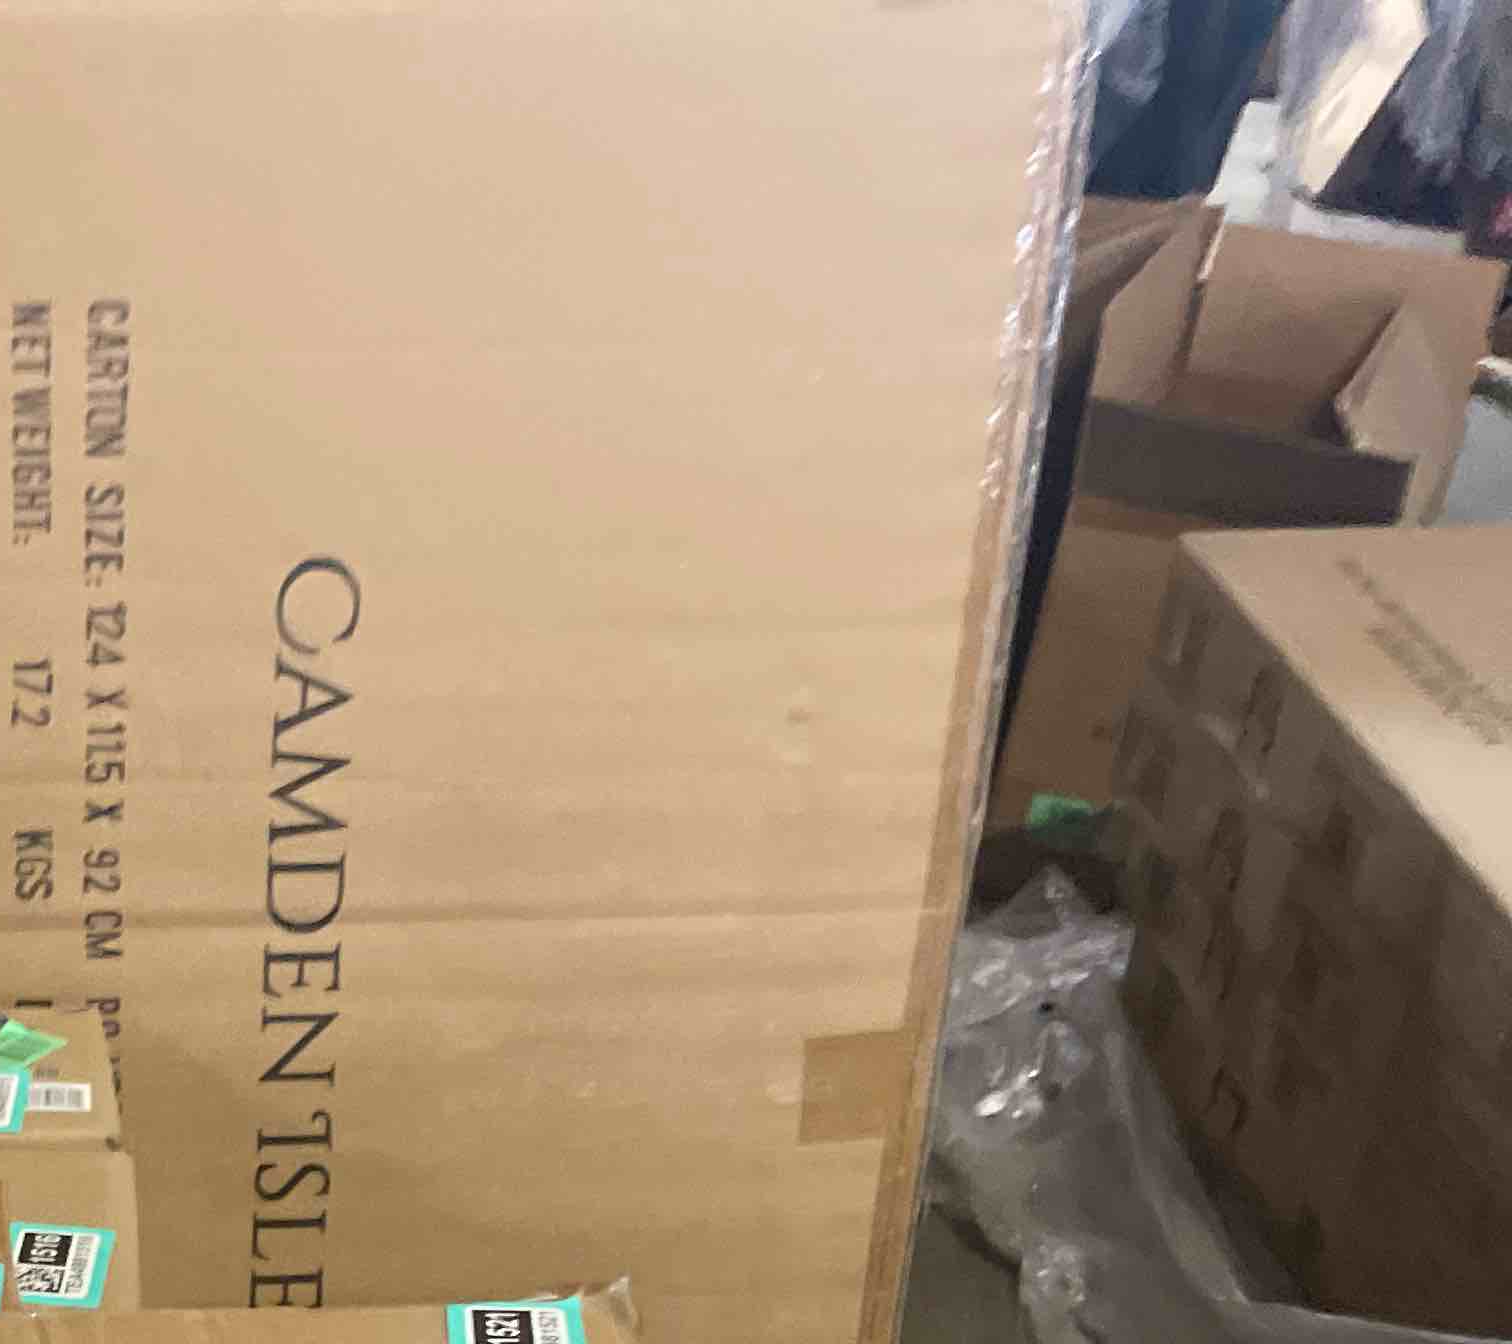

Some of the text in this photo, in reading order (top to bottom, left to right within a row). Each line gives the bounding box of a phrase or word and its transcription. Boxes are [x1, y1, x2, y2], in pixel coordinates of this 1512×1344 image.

[12, 300, 54, 378] NET
[86, 298, 130, 458] CARTON
[12, 385, 54, 547] WEIGHT:
[84, 482, 126, 588] SIZE:
[85, 601, 129, 668] 124
[85, 686, 129, 712] X
[83, 798, 126, 825] X
[13, 827, 54, 904] KGS
[84, 848, 122, 895] 92
[85, 909, 125, 962] CM
[248, 555, 362, 1309] CAMDEN ISLE
[484, 1311, 521, 1344] 1521
